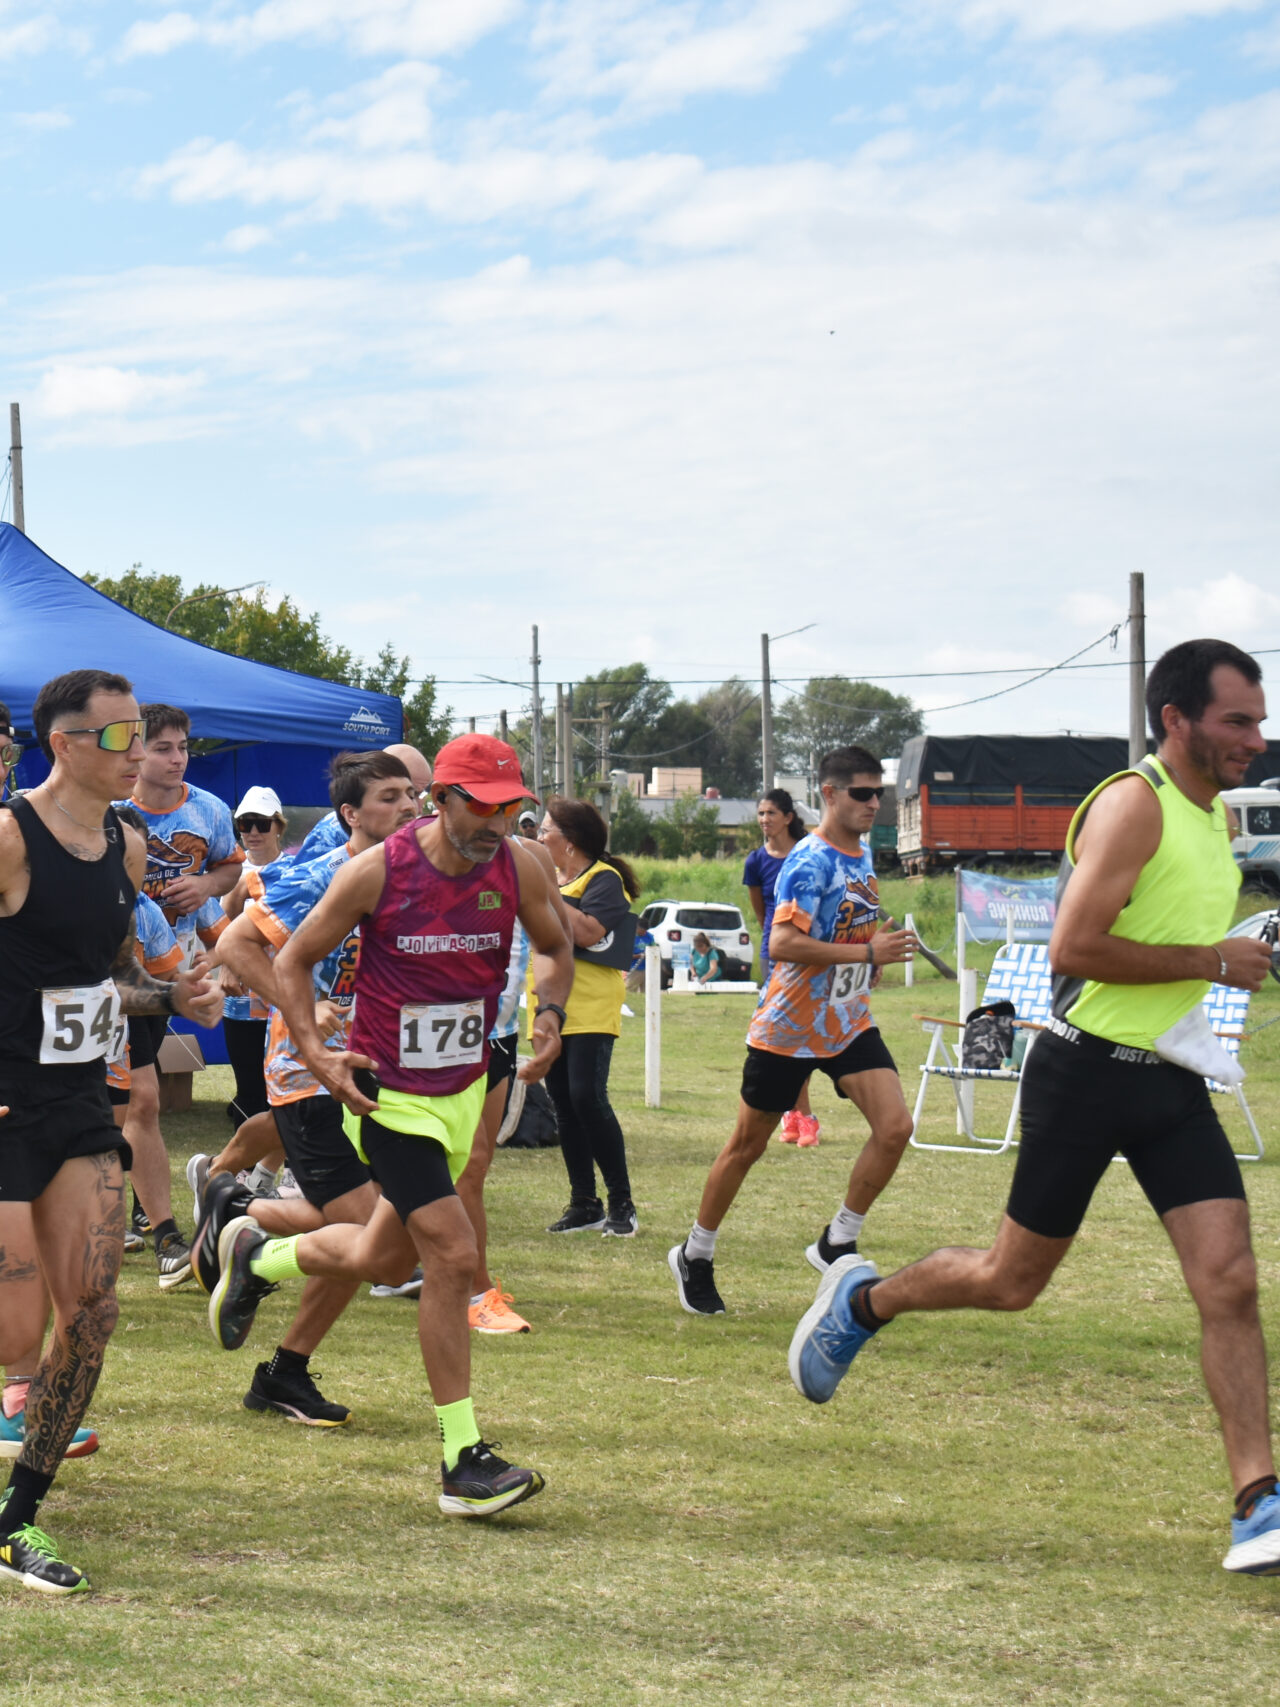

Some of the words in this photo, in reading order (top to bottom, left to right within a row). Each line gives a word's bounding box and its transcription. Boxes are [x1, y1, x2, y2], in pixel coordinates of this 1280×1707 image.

[342, 722, 369, 732] SOUTH
[370, 725, 390, 736] PORT
[165, 869, 175, 877] DE
[837, 901, 855, 929] 3
[340, 938, 360, 970] 3
[53, 996, 113, 1052] 54
[403, 1014, 483, 1053] 178
[1110, 1045, 1146, 1063] JUST
